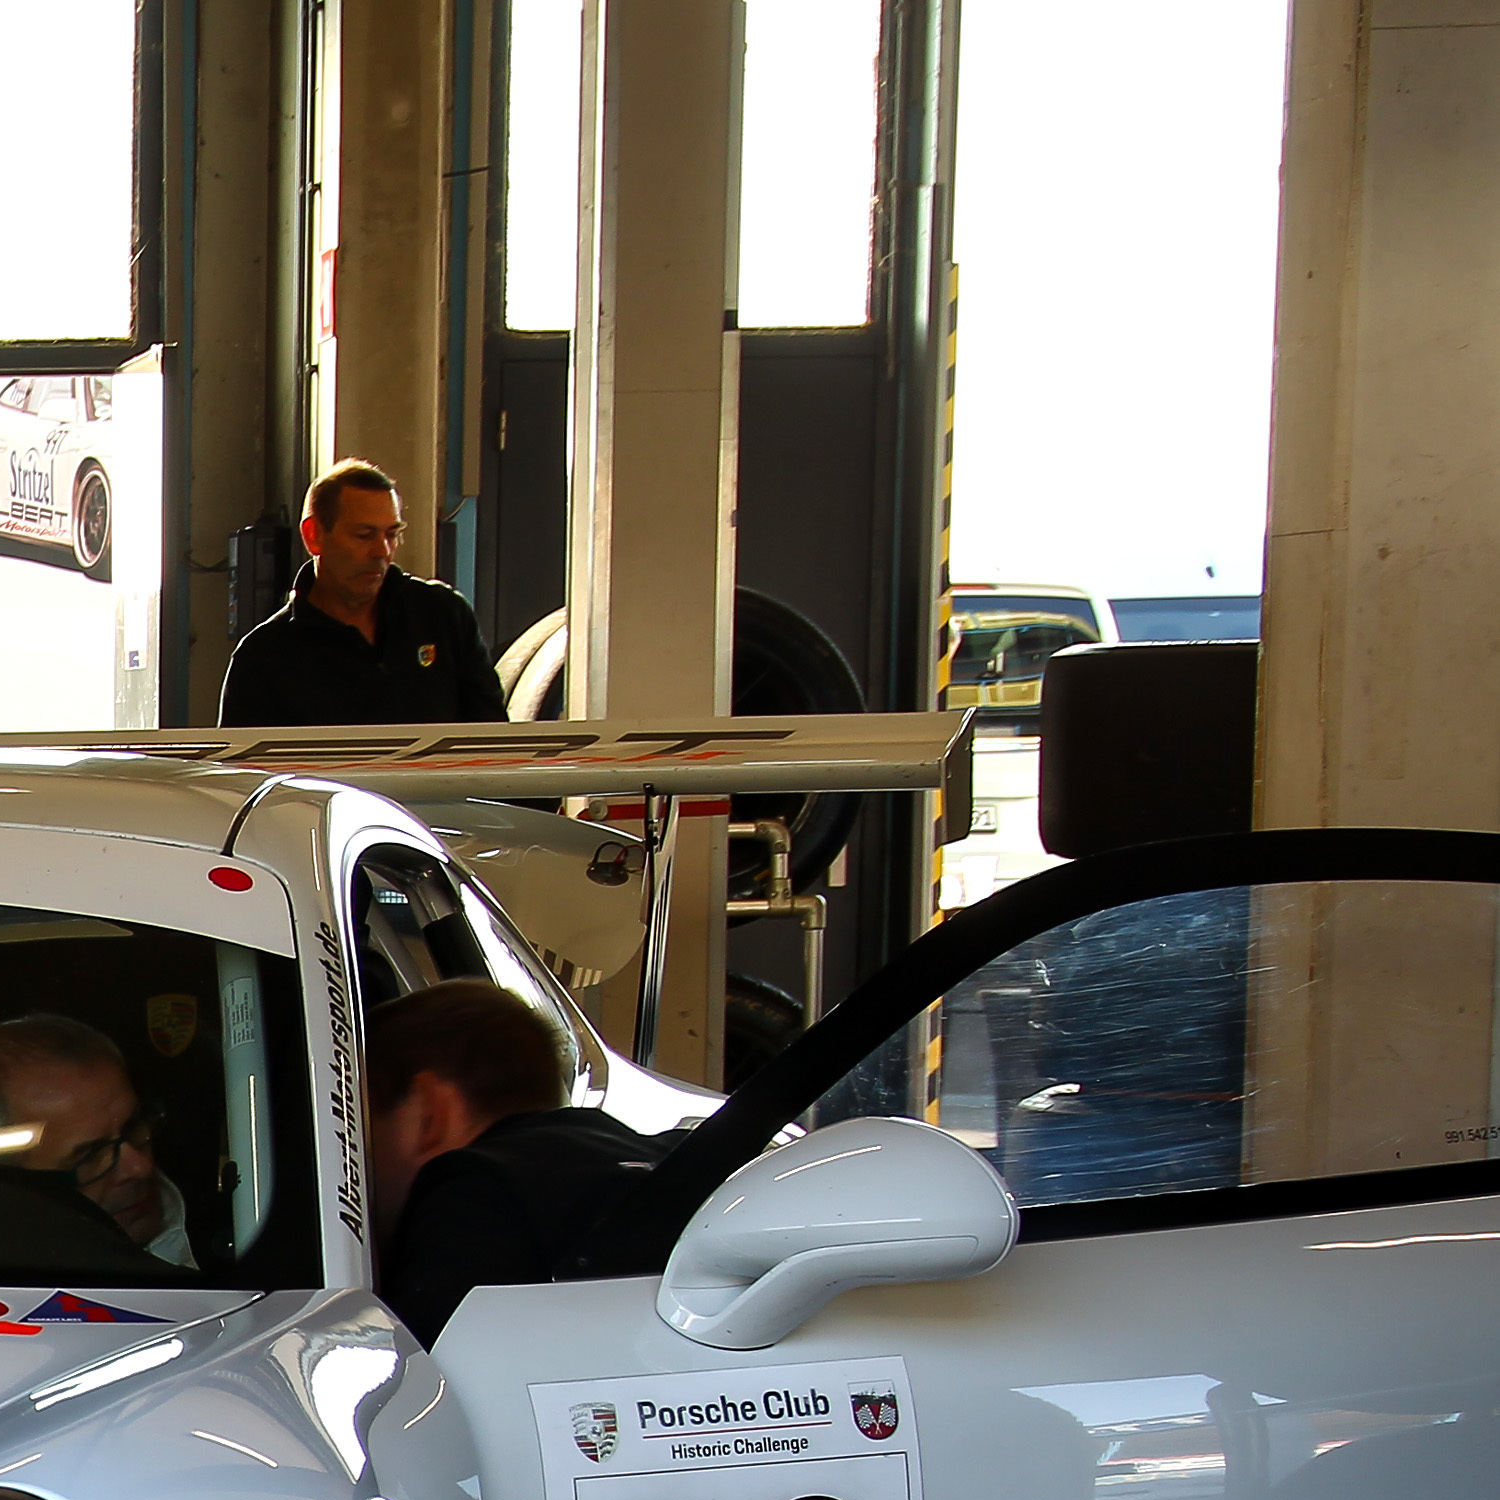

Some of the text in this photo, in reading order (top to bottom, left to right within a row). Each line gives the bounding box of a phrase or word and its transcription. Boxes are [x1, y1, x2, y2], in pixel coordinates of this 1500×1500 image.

[636, 1388, 831, 1429] Porsche Club
[671, 1435, 810, 1460] Historic Challenge
